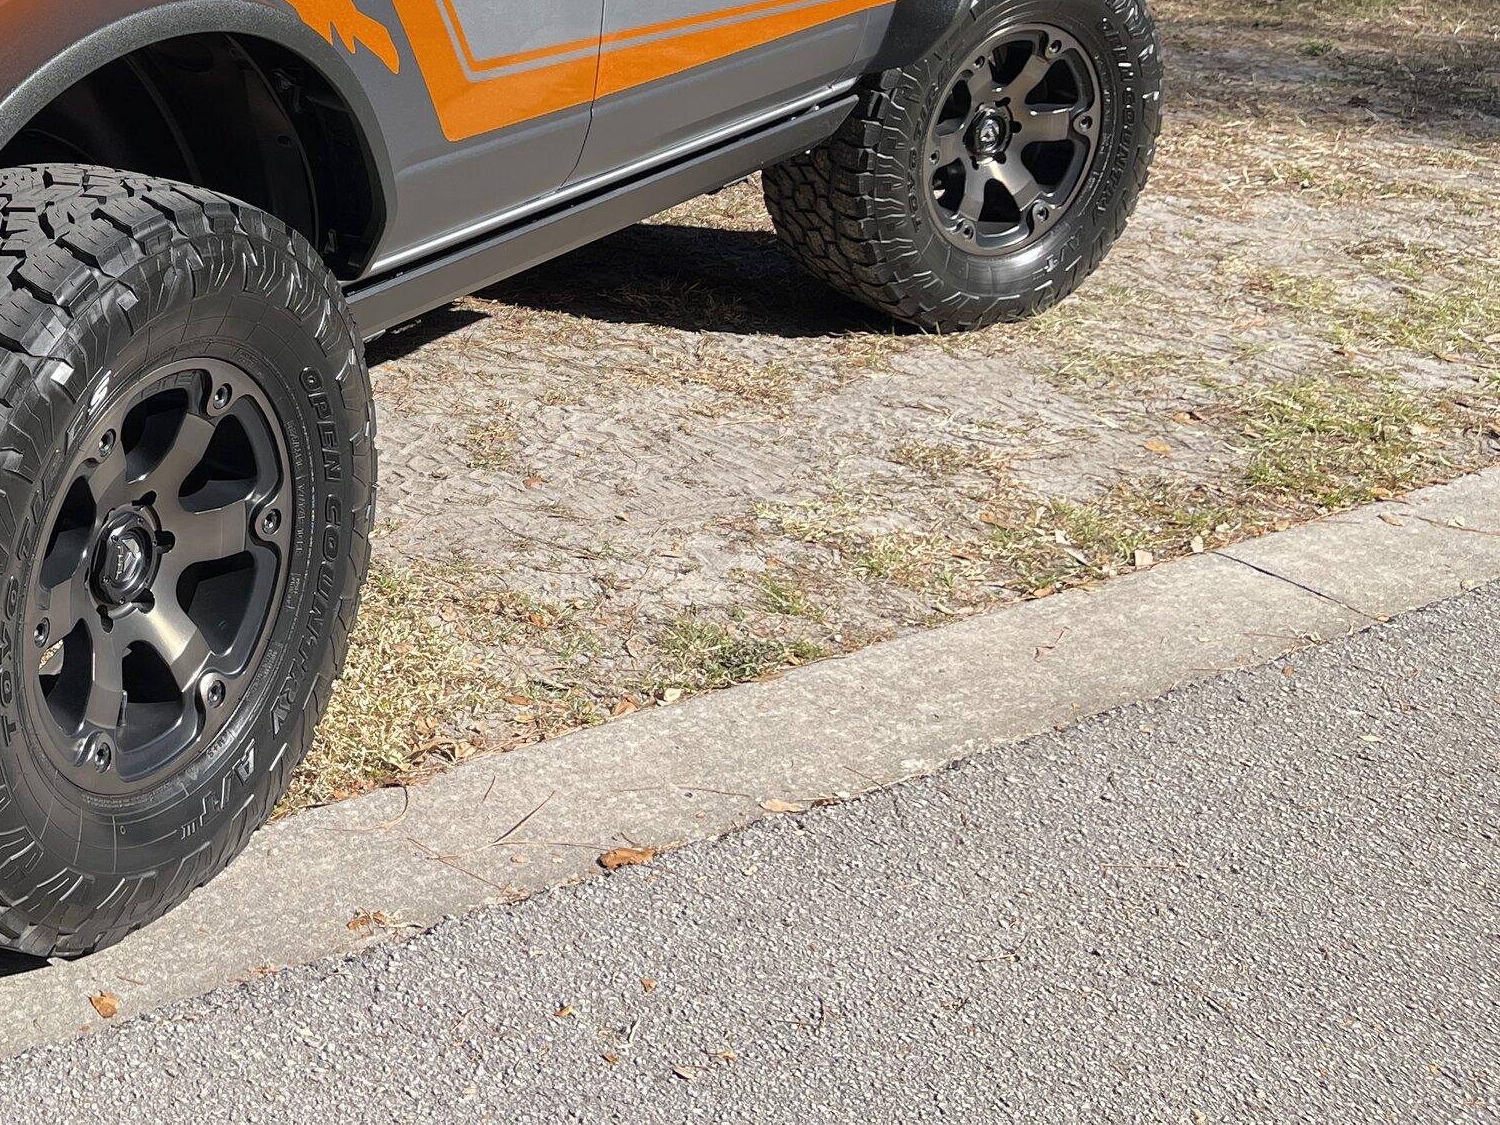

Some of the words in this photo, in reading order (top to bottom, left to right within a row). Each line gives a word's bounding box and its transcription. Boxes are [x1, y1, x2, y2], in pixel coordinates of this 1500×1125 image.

[300, 365, 342, 482] OPEN
[0, 575, 19, 747] TOYO
[269, 493, 342, 741] COUNTRY
